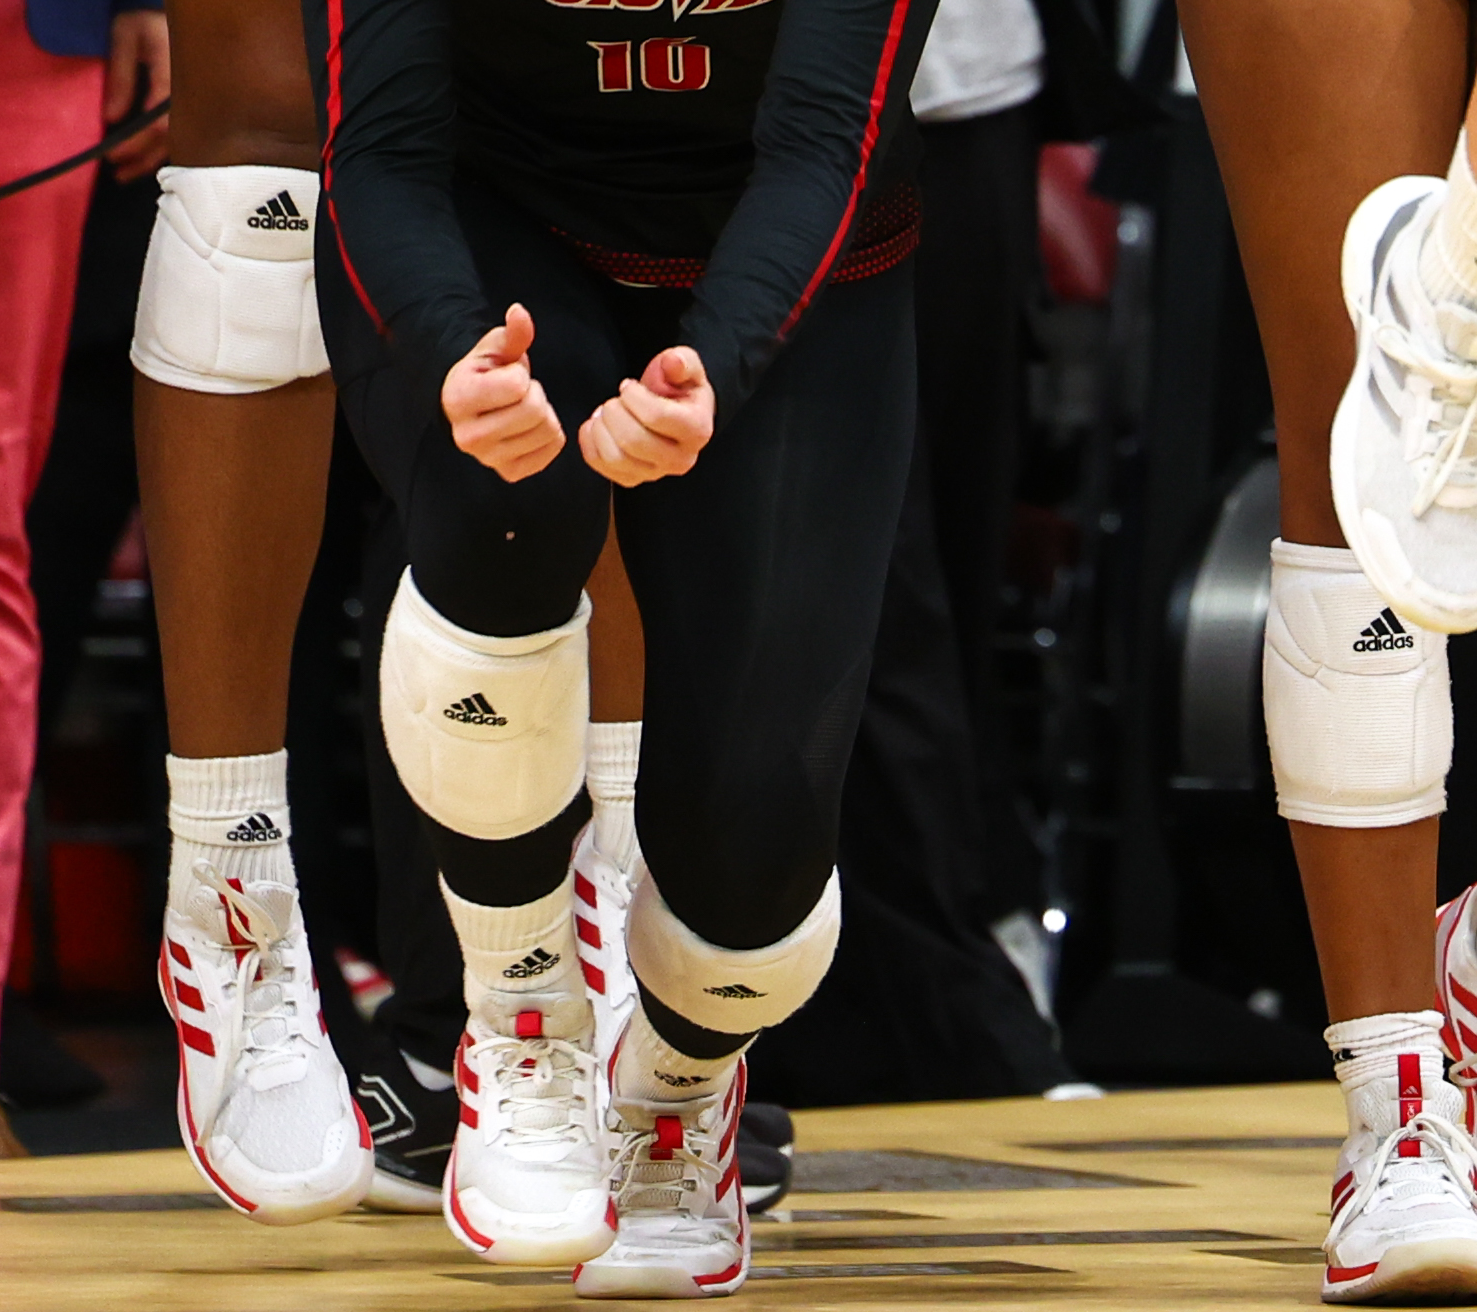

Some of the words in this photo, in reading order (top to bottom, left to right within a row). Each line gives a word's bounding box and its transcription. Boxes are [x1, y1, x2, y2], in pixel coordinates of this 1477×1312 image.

[586, 35, 711, 93] 10
[248, 215, 309, 231] adidas
[1353, 635, 1414, 652] adidas
[443, 707, 508, 727] adidas
[227, 827, 283, 842] adidas
